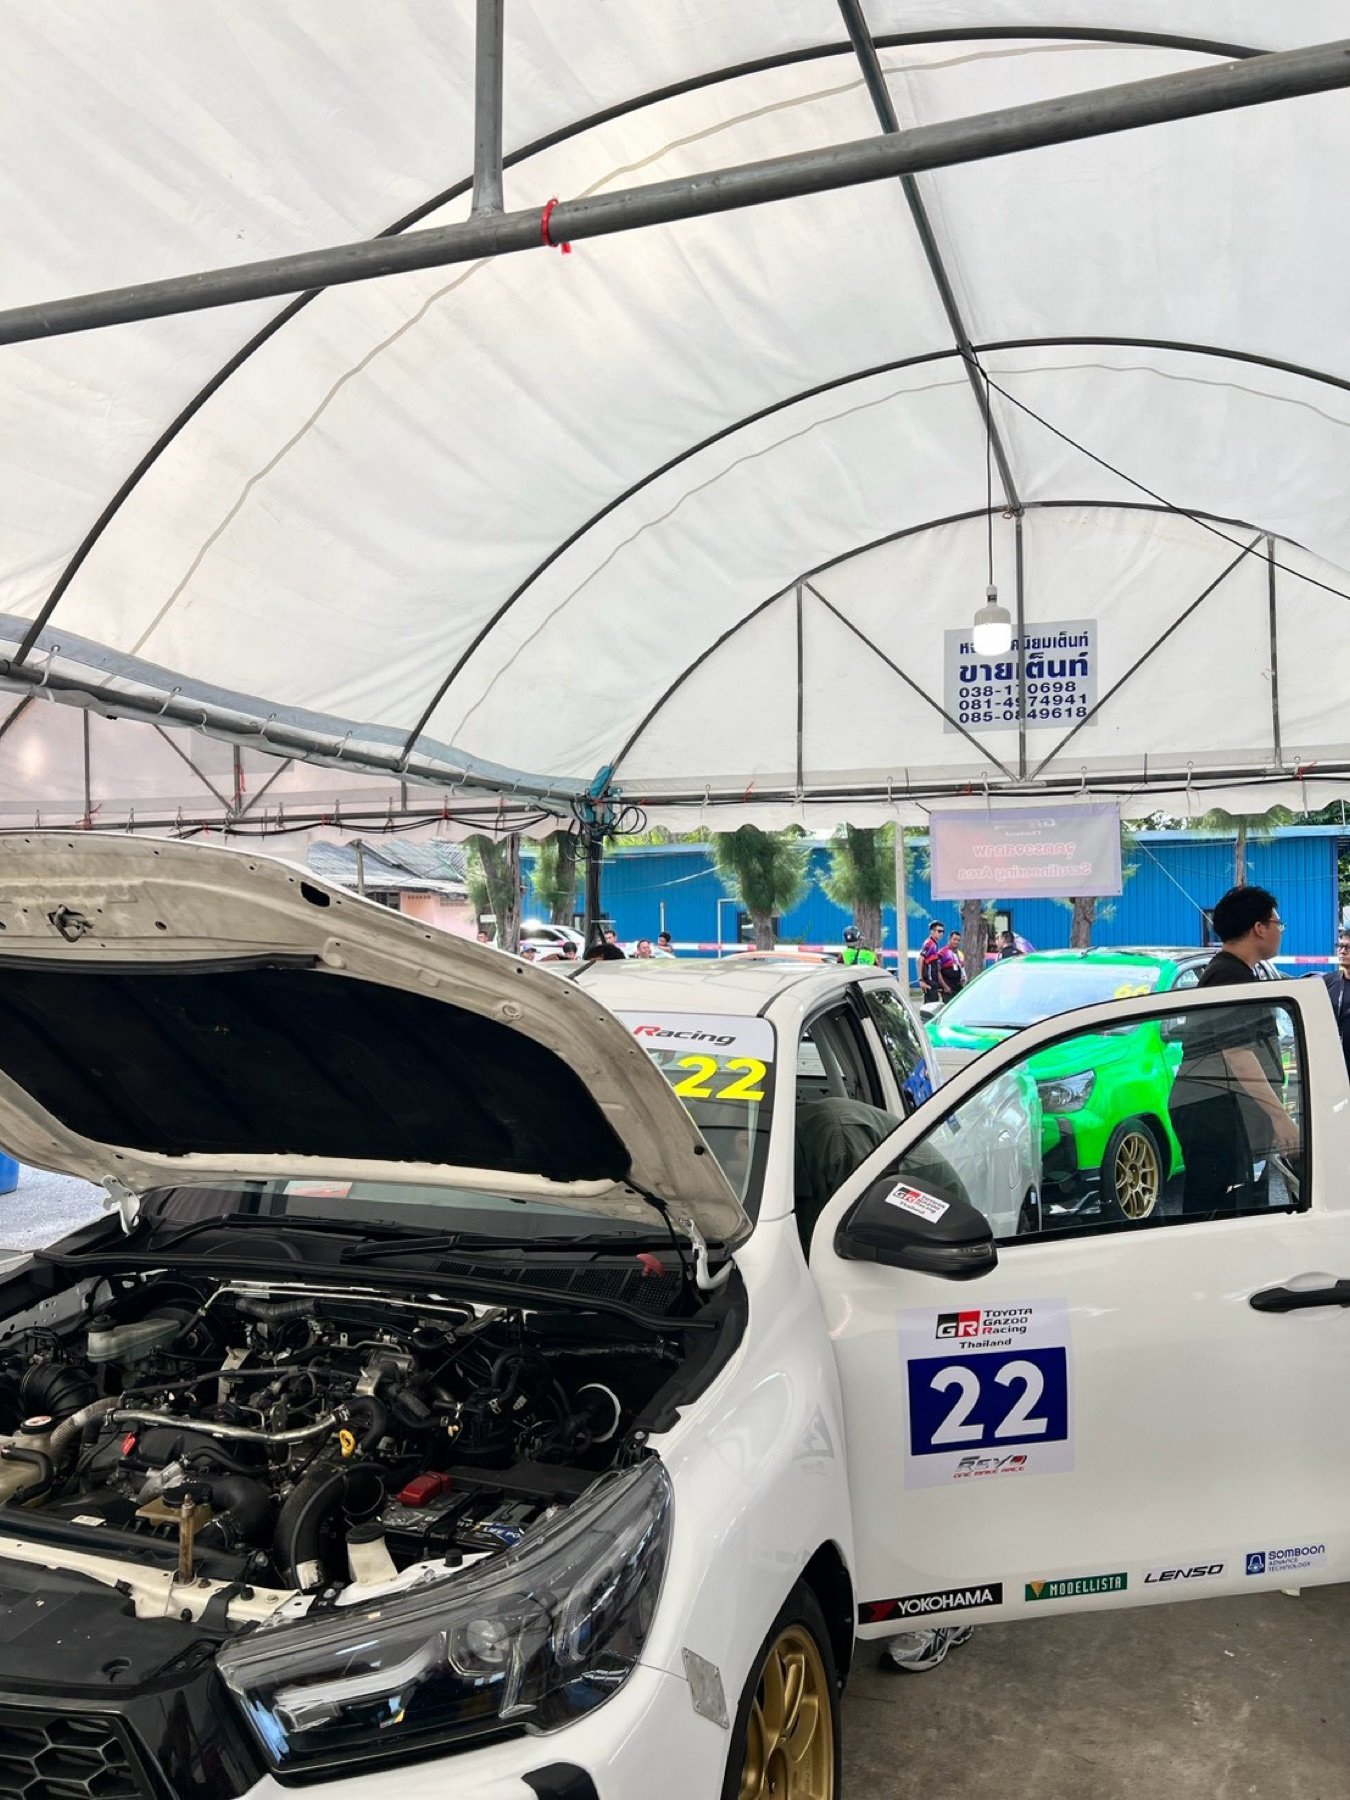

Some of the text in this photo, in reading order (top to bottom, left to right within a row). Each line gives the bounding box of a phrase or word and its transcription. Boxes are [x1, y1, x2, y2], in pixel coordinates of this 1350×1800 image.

[632, 1025, 737, 1047] Racing
[673, 1055, 767, 1101] 22
[983, 1316, 1028, 1326] GAZOO
[984, 1308, 1033, 1318] TOYOTA
[937, 1320, 978, 1338] GR
[982, 1325, 1027, 1335] Racing
[959, 1338, 1012, 1349] Thailand
[930, 1360, 1048, 1445] 22
[1144, 1563, 1224, 1584] LENSO
[1050, 1576, 1122, 1597] MODELLISTA
[898, 1588, 993, 1615] YOKOHAMA
